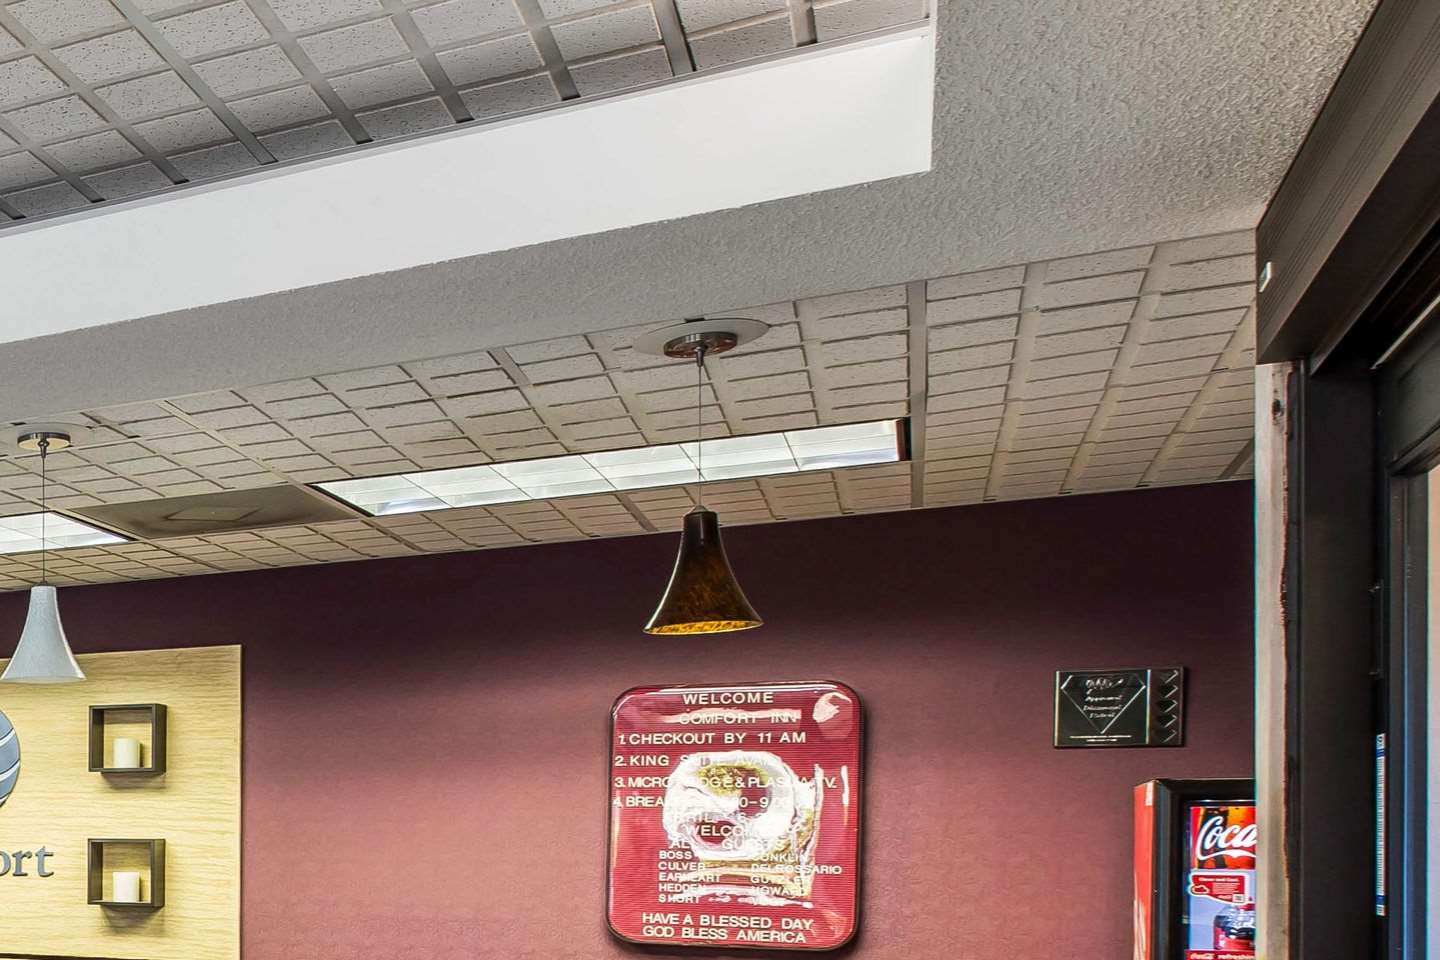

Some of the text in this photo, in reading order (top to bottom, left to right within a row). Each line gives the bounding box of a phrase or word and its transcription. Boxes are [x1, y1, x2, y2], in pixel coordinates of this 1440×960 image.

[682, 692, 774, 705] WELCOME
[628, 732, 716, 745] CHECKOUT
[724, 732, 747, 744] BY
[757, 731, 773, 744] 11
[779, 731, 807, 744] AM
[629, 754, 670, 767] KING
[658, 850, 693, 860] BOSS
[657, 861, 706, 872] CULVER
[641, 912, 813, 930] HAVE A BLESSED DAY
[642, 925, 807, 943] GOD BLESS AMERICA
